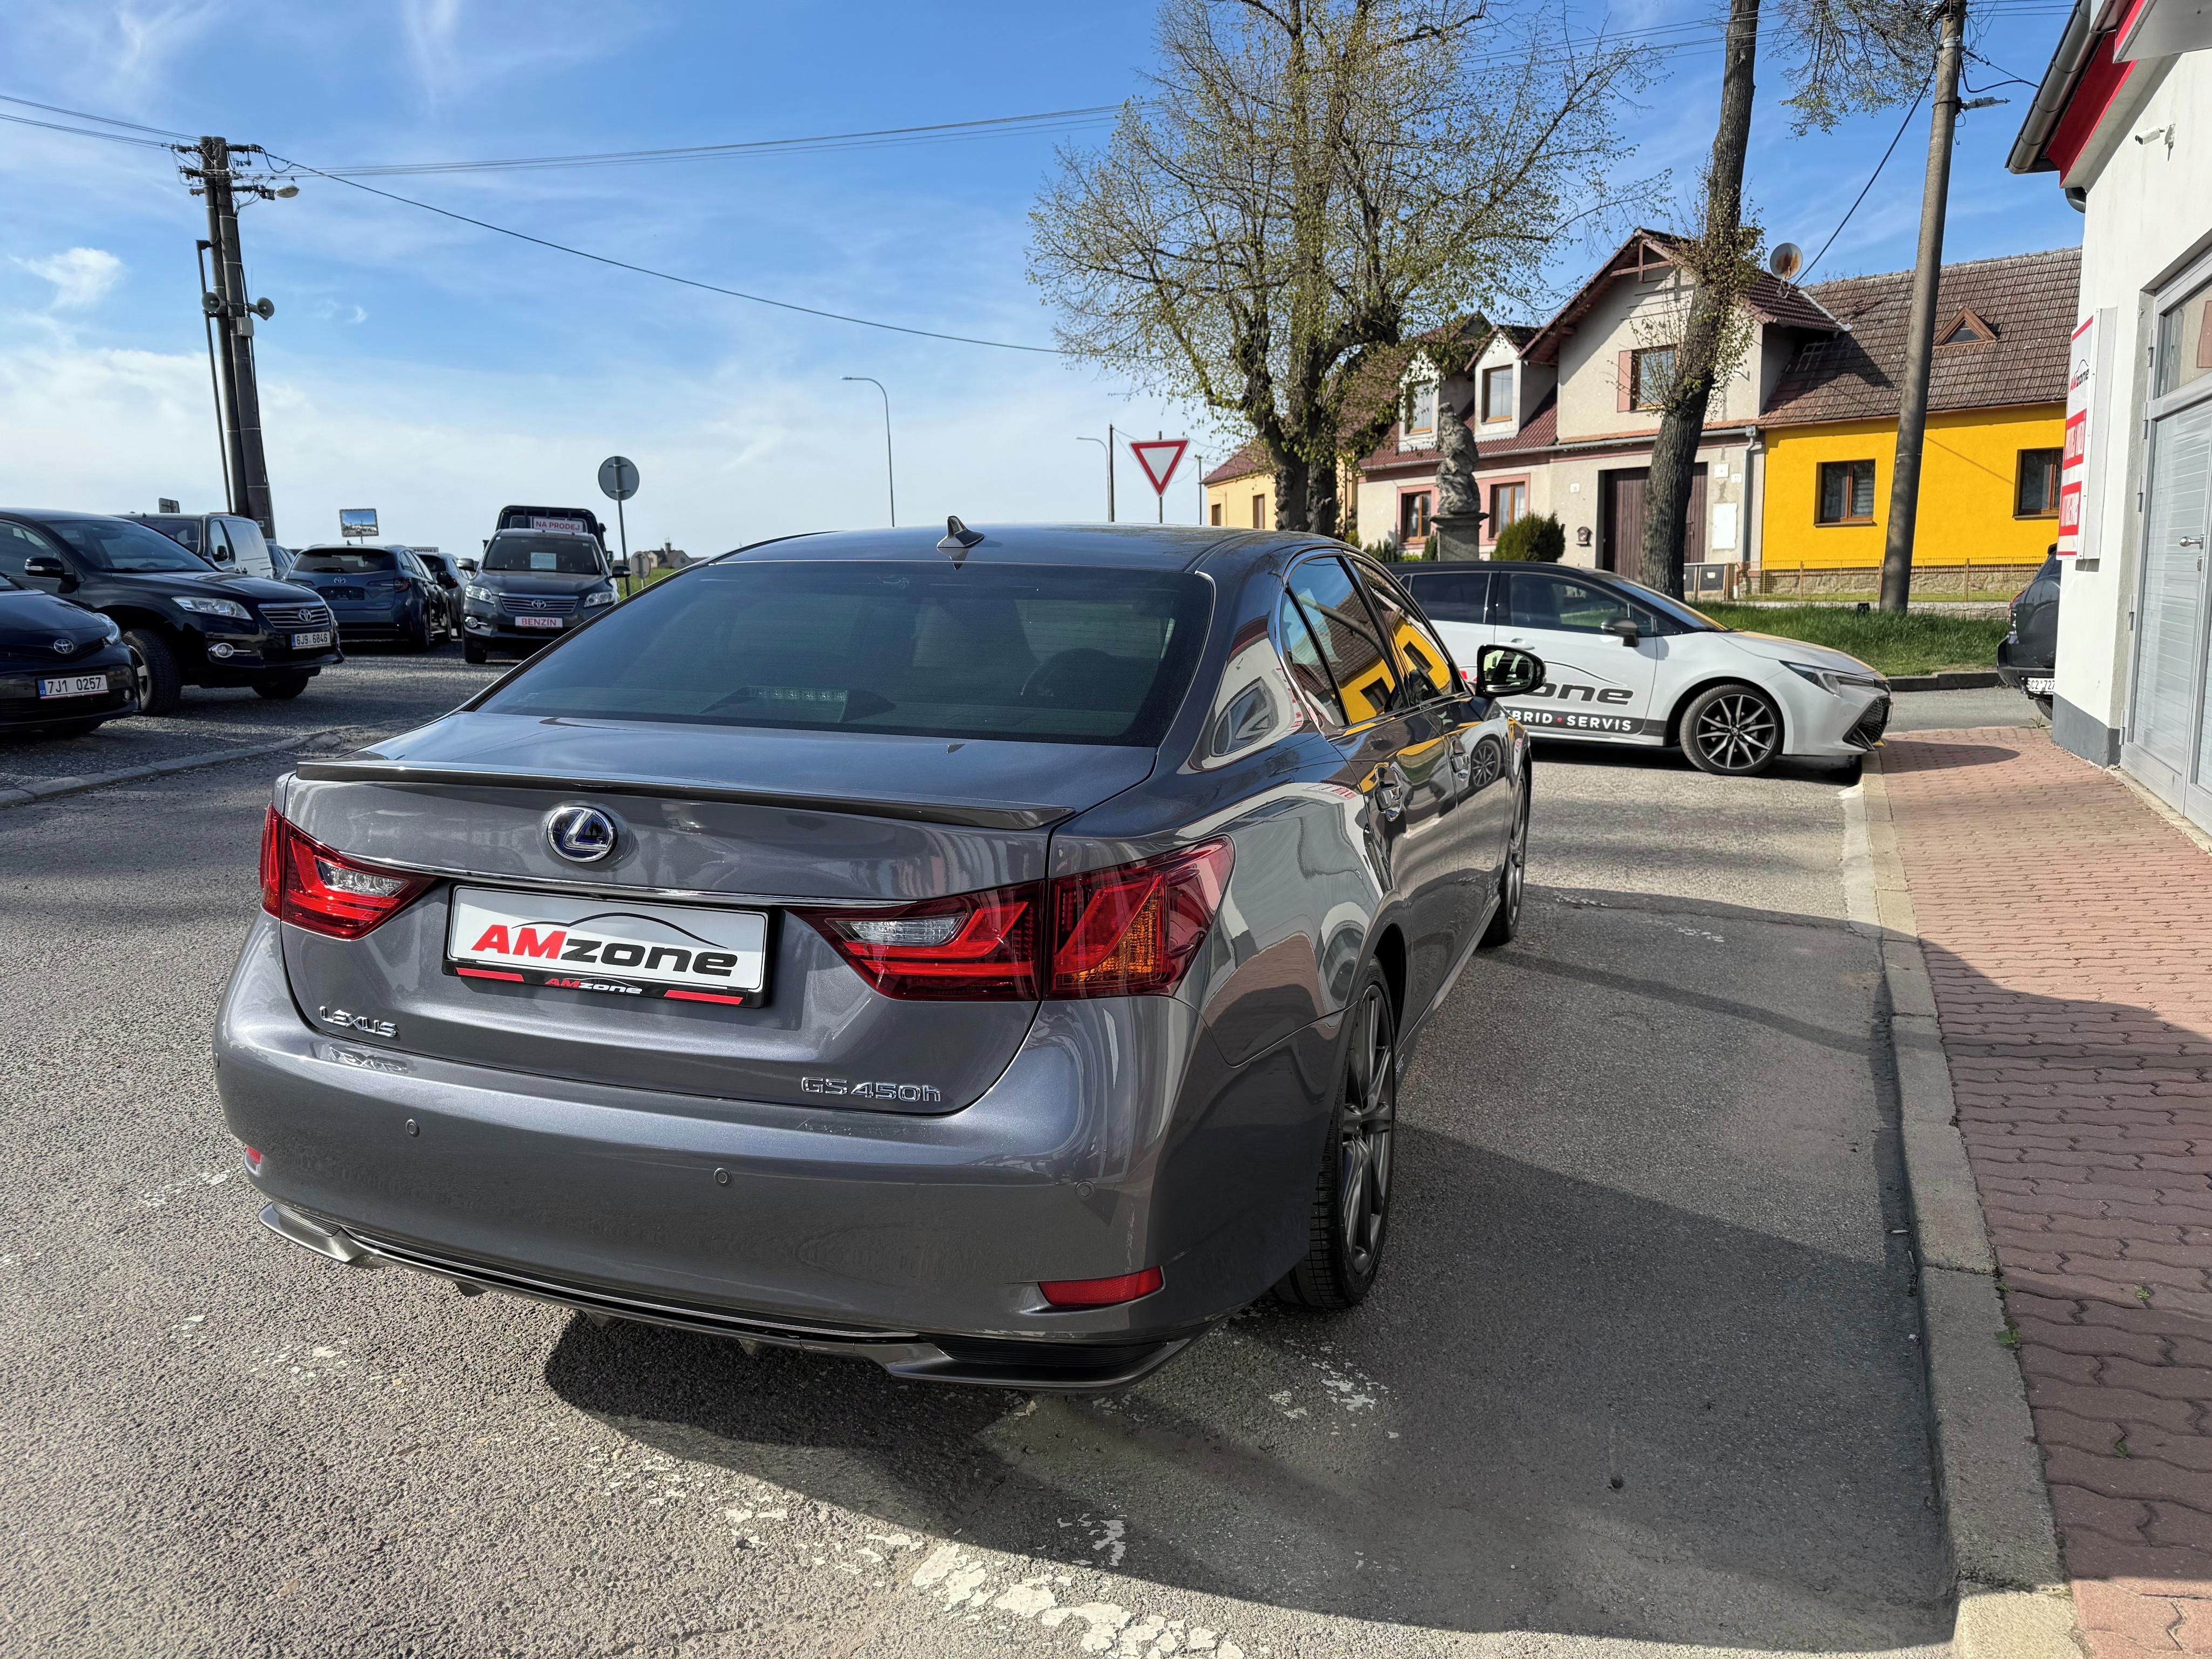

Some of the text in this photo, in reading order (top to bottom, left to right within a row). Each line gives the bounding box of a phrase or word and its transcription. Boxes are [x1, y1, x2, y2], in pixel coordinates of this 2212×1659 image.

[2070, 368, 2089, 392] AMzone
[549, 522, 580, 531] PRODEJ
[522, 617, 557, 626] BENZÍN
[296, 633, 328, 645] 6J9 6846
[48, 677, 101, 693] 7J1 0257
[1523, 683, 1634, 705] one
[1507, 710, 1631, 731] BRID SERVIS
[471, 924, 738, 977] AMzone
[544, 978, 643, 994] AMzone
[319, 1006, 396, 1037] LEXUS
[801, 1077, 941, 1102] GS 450h
